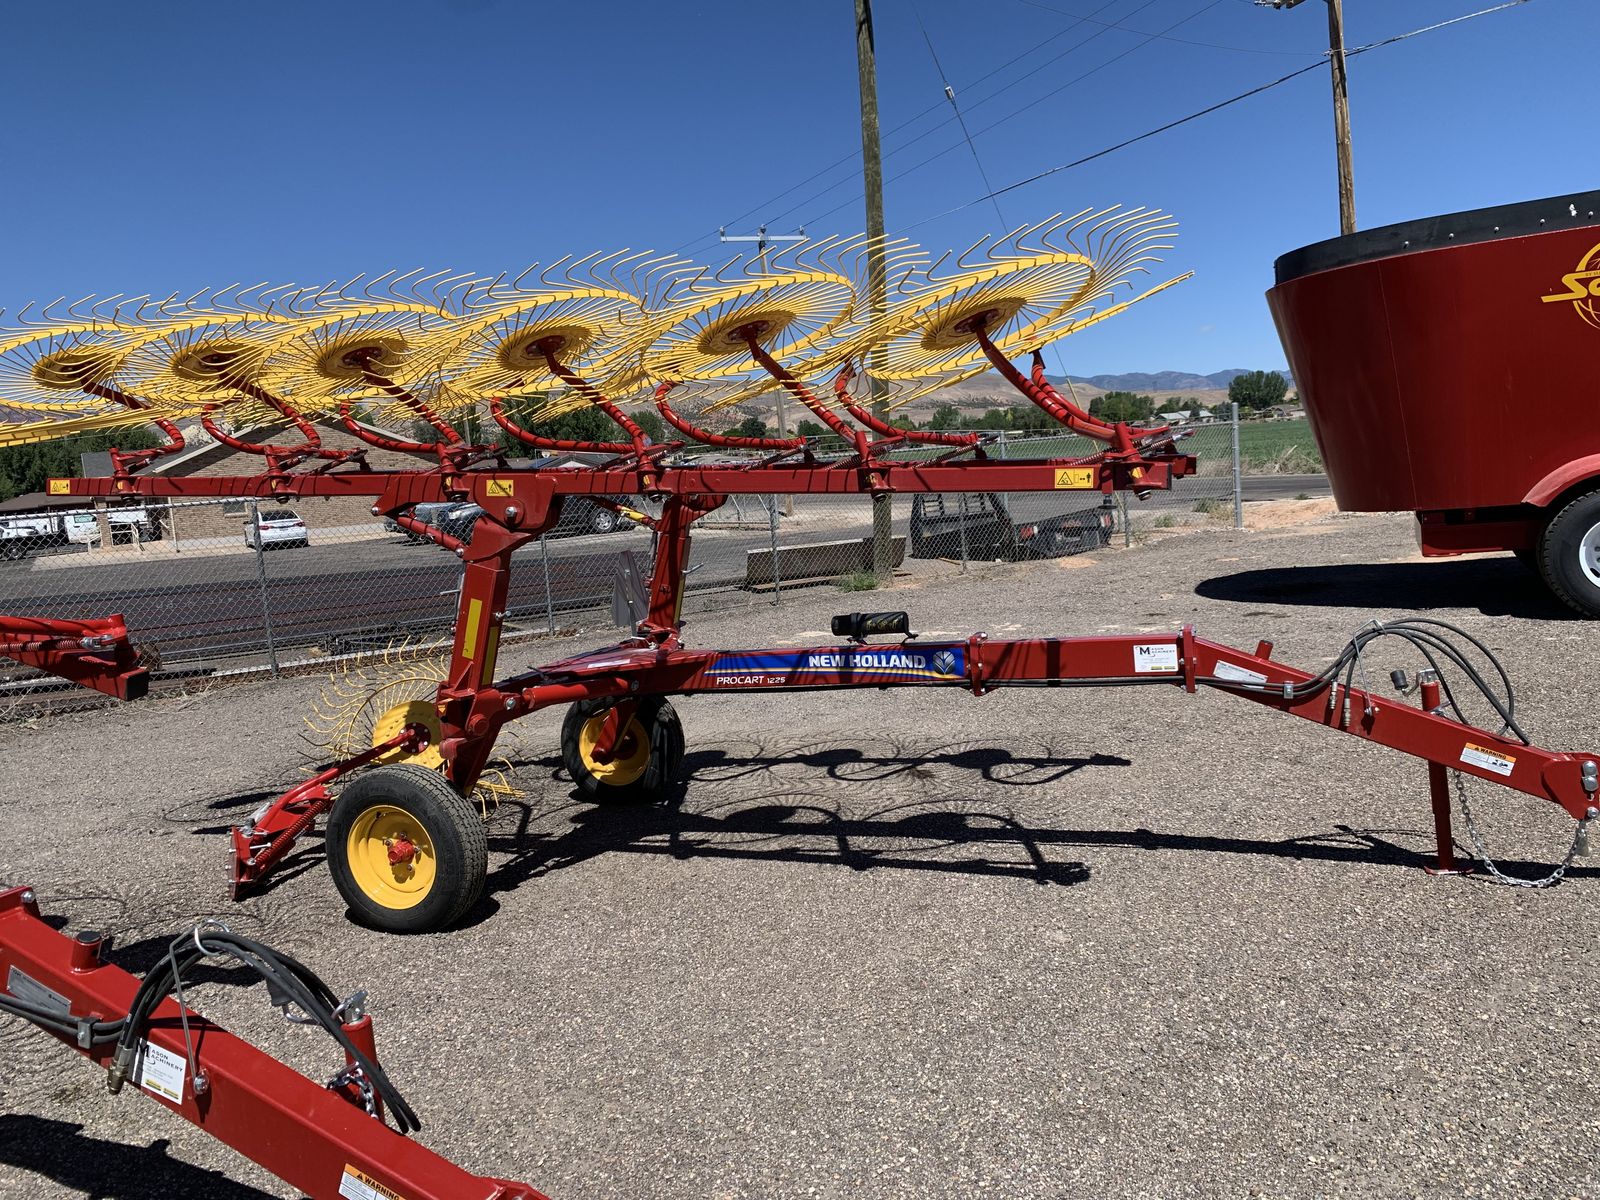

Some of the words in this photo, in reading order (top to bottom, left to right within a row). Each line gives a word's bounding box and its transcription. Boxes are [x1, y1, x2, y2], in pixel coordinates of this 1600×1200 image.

[809, 655, 846, 667] NEW
[849, 655, 926, 669] HOLLAND
[717, 675, 764, 685] PROCART
[767, 676, 786, 684] 1225
[1480, 747, 1507, 760] WARNING
